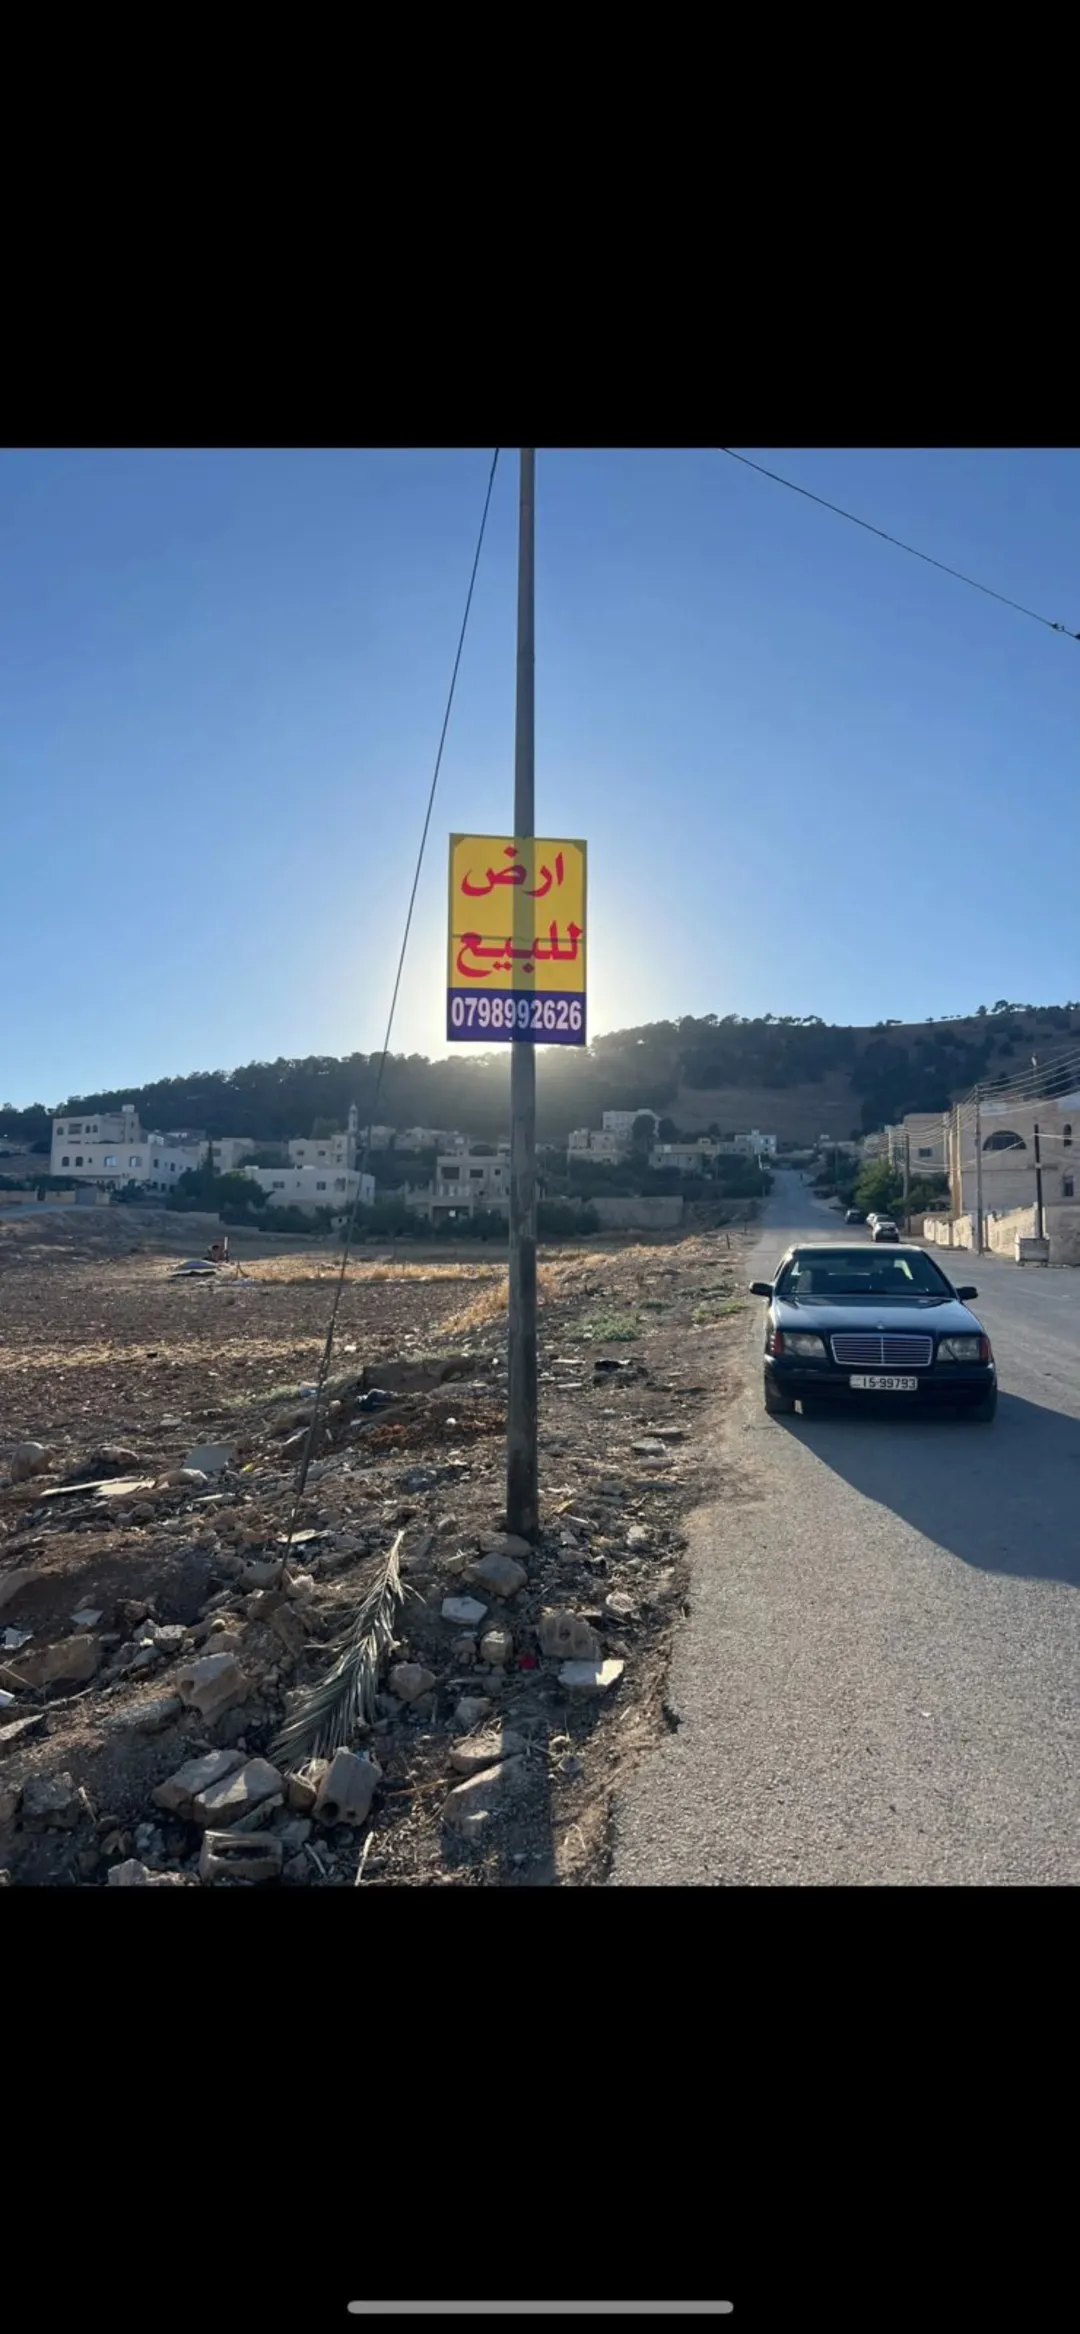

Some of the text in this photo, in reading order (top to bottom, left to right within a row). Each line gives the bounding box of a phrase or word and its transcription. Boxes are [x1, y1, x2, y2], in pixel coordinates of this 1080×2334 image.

[461, 846, 564, 897] ارض
[456, 920, 583, 978] للبيع
[451, 997, 582, 1030] 0798992626
